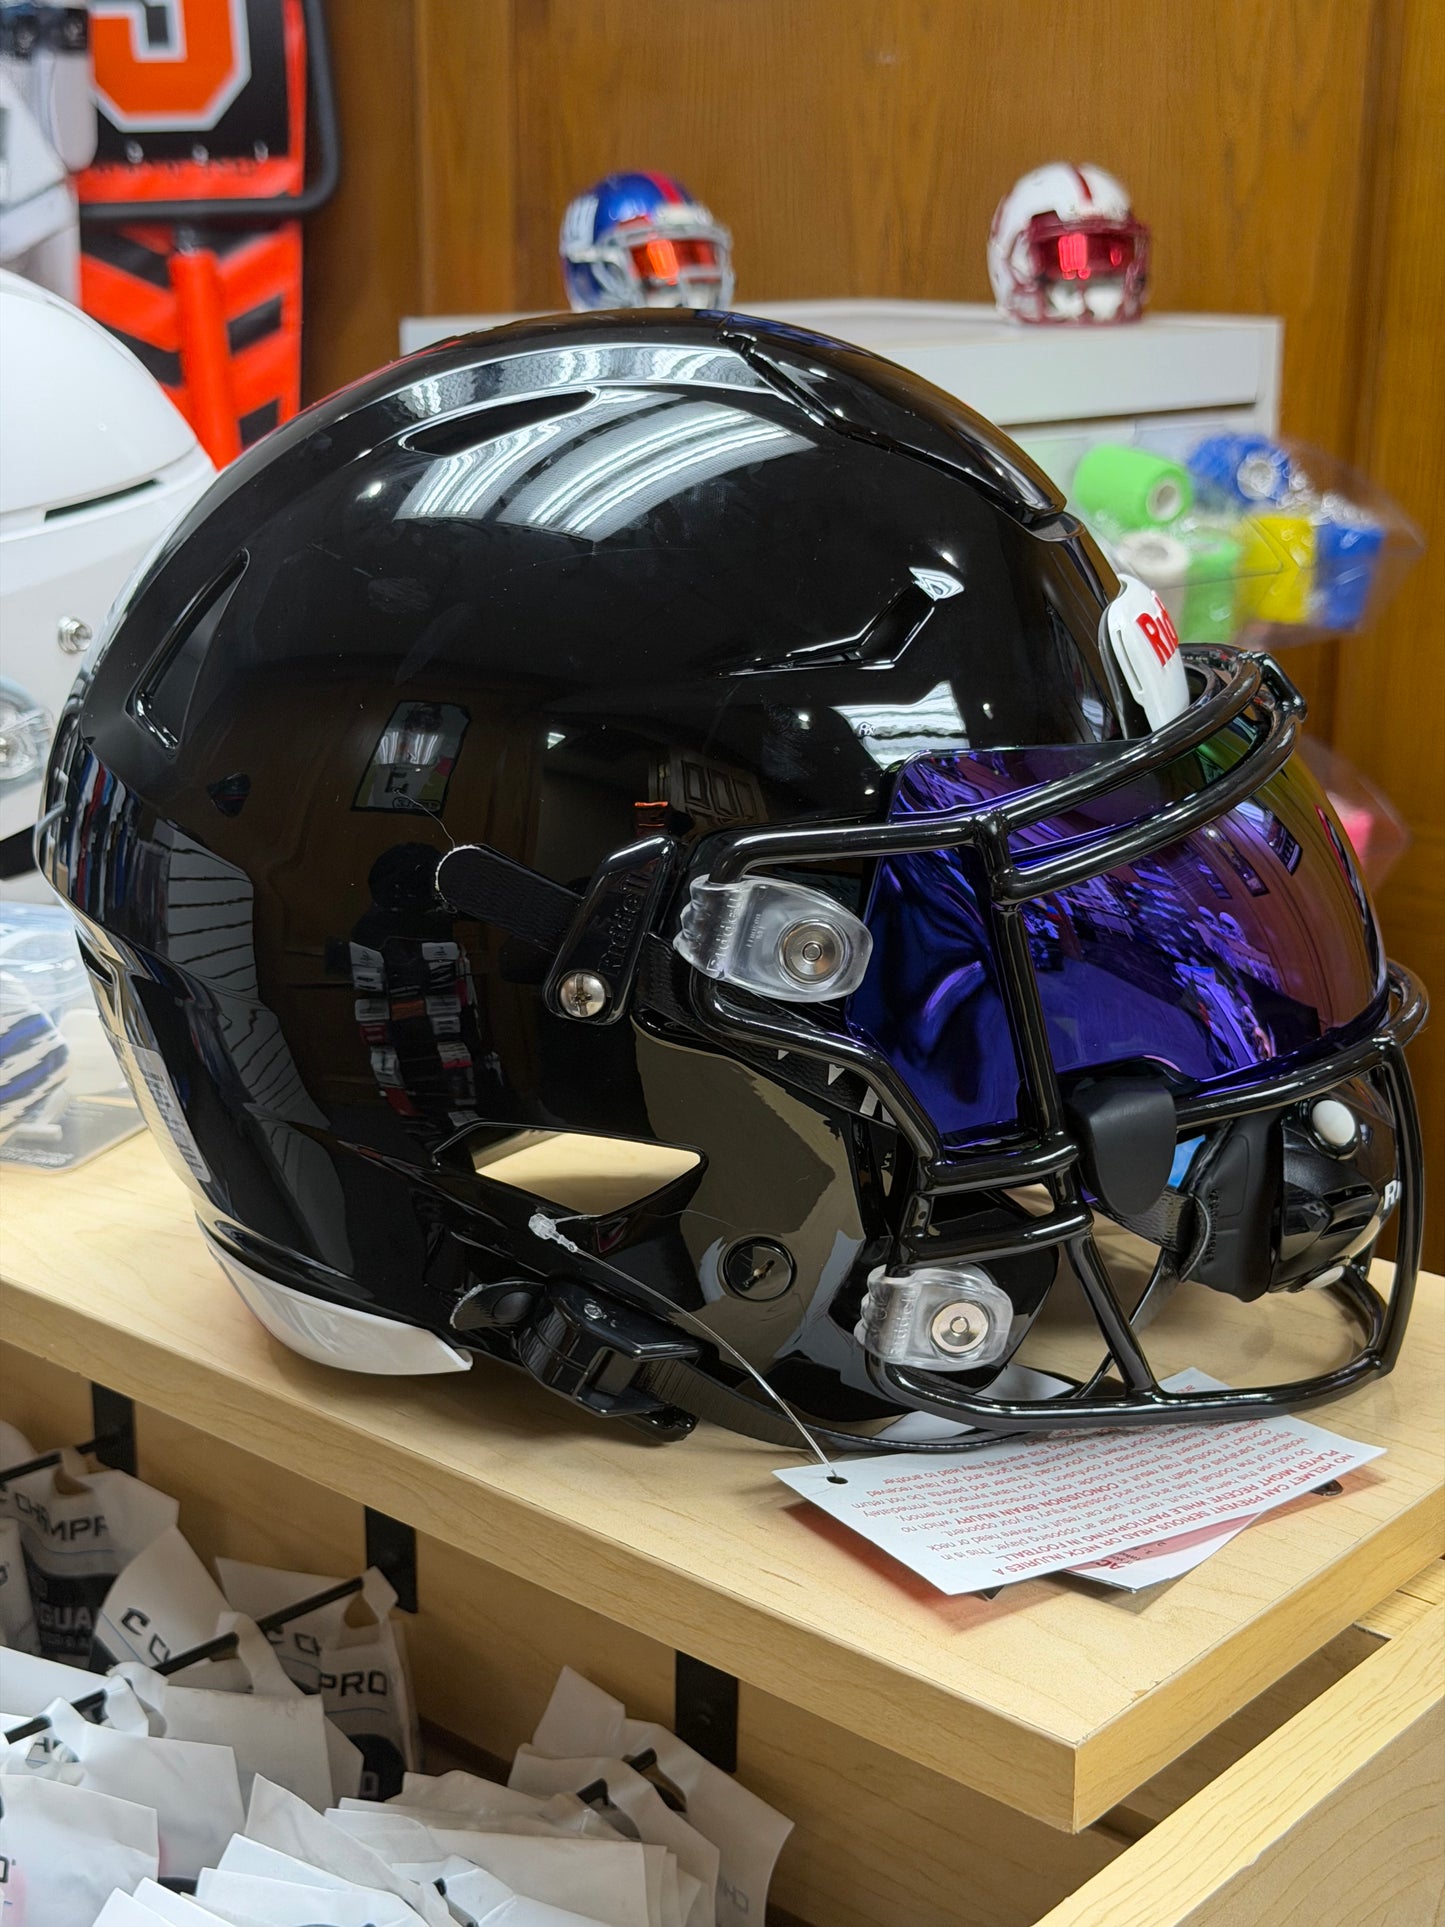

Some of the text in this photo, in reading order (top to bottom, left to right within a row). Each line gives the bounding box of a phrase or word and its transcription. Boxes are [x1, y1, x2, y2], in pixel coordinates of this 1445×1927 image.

[1232, 1417, 1264, 1433] helmet
[1211, 1431, 1230, 1440] can
[1230, 1428, 1271, 1445] Contact
[1266, 1437, 1305, 1456] violation
[1294, 1448, 1313, 1456] Do
[1182, 1449, 1221, 1464] football
[1210, 1445, 1255, 1466] paralysis
[1276, 1455, 1295, 1464] not
[1294, 1450, 1339, 1470] PLAYER
[1115, 1454, 1171, 1473] Symptoms
[1158, 1462, 1182, 1471] may
[1236, 1459, 1256, 1468] the
[1257, 1462, 1276, 1472] use
[1130, 1469, 1159, 1481] result
[1168, 1468, 1198, 1480] death
[1198, 1466, 1238, 1483] football
[1236, 1471, 1260, 1480] this
[1258, 1468, 1297, 1486] MIGHT
[1051, 1484, 1076, 1493] loss
[1134, 1480, 1156, 1490] you
[1172, 1480, 1199, 1490] rules
[1202, 1479, 1240, 1493] helmet
[1112, 1488, 1135, 1498] and
[1150, 1488, 1172, 1498] and
[1207, 1484, 1259, 1503] RECEIVE
[959, 1493, 1038, 1512] consciousness
[1068, 1494, 1113, 1510] possible
[1124, 1494, 1151, 1505] such
[1102, 1503, 1124, 1512] use
[1129, 1508, 1142, 1516] or
[1141, 1502, 1164, 1511] ram
[1168, 1500, 1210, 1515] WHILE
[992, 1454, 1355, 1576] NO HELMET CAN PREVENT SERIOUS HEAD OR NECK INJURIES A
[1037, 1507, 1068, 1518] injury
[1081, 1509, 1103, 1518] can
[955, 1512, 1000, 1525] INJURY
[999, 1516, 1024, 1527] your
[1049, 1515, 1082, 1527] result
[1098, 1513, 1128, 1526] spear
[901, 1525, 917, 1533] no
[918, 1520, 952, 1530] which
[1081, 1522, 1097, 1530] an
[1081, 1512, 1171, 1542] PARTICIPATING
[1000, 1527, 1038, 1537] severe
[1027, 1527, 1081, 1542] opposing
[970, 1533, 1002, 1544] head
[1065, 1538, 1083, 1546] IN
[927, 1542, 956, 1551] neck
[953, 1551, 965, 1560] is
[965, 1547, 993, 1558] This
